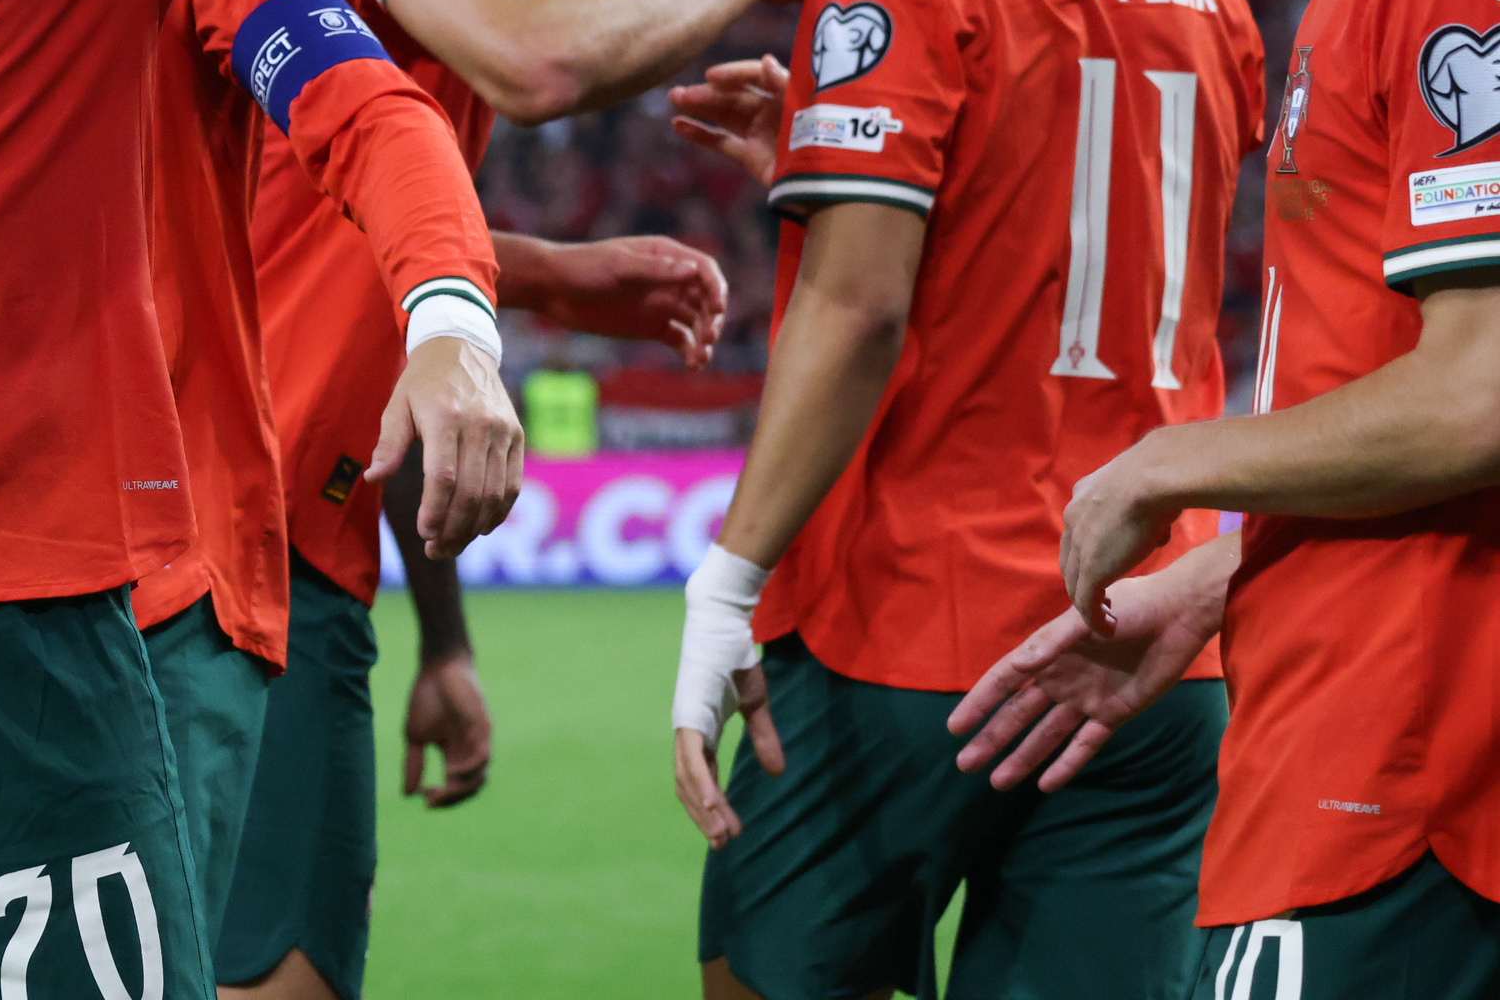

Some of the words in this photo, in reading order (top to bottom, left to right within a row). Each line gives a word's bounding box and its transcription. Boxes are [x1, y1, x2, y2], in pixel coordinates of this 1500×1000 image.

[850, 117, 881, 139] 10
[1413, 175, 1437, 187] UEFA
[1050, 57, 1198, 391] 11
[122, 479, 179, 490] ULTRAWEAVE
[1318, 799, 1381, 815] ULTRAWEAVE
